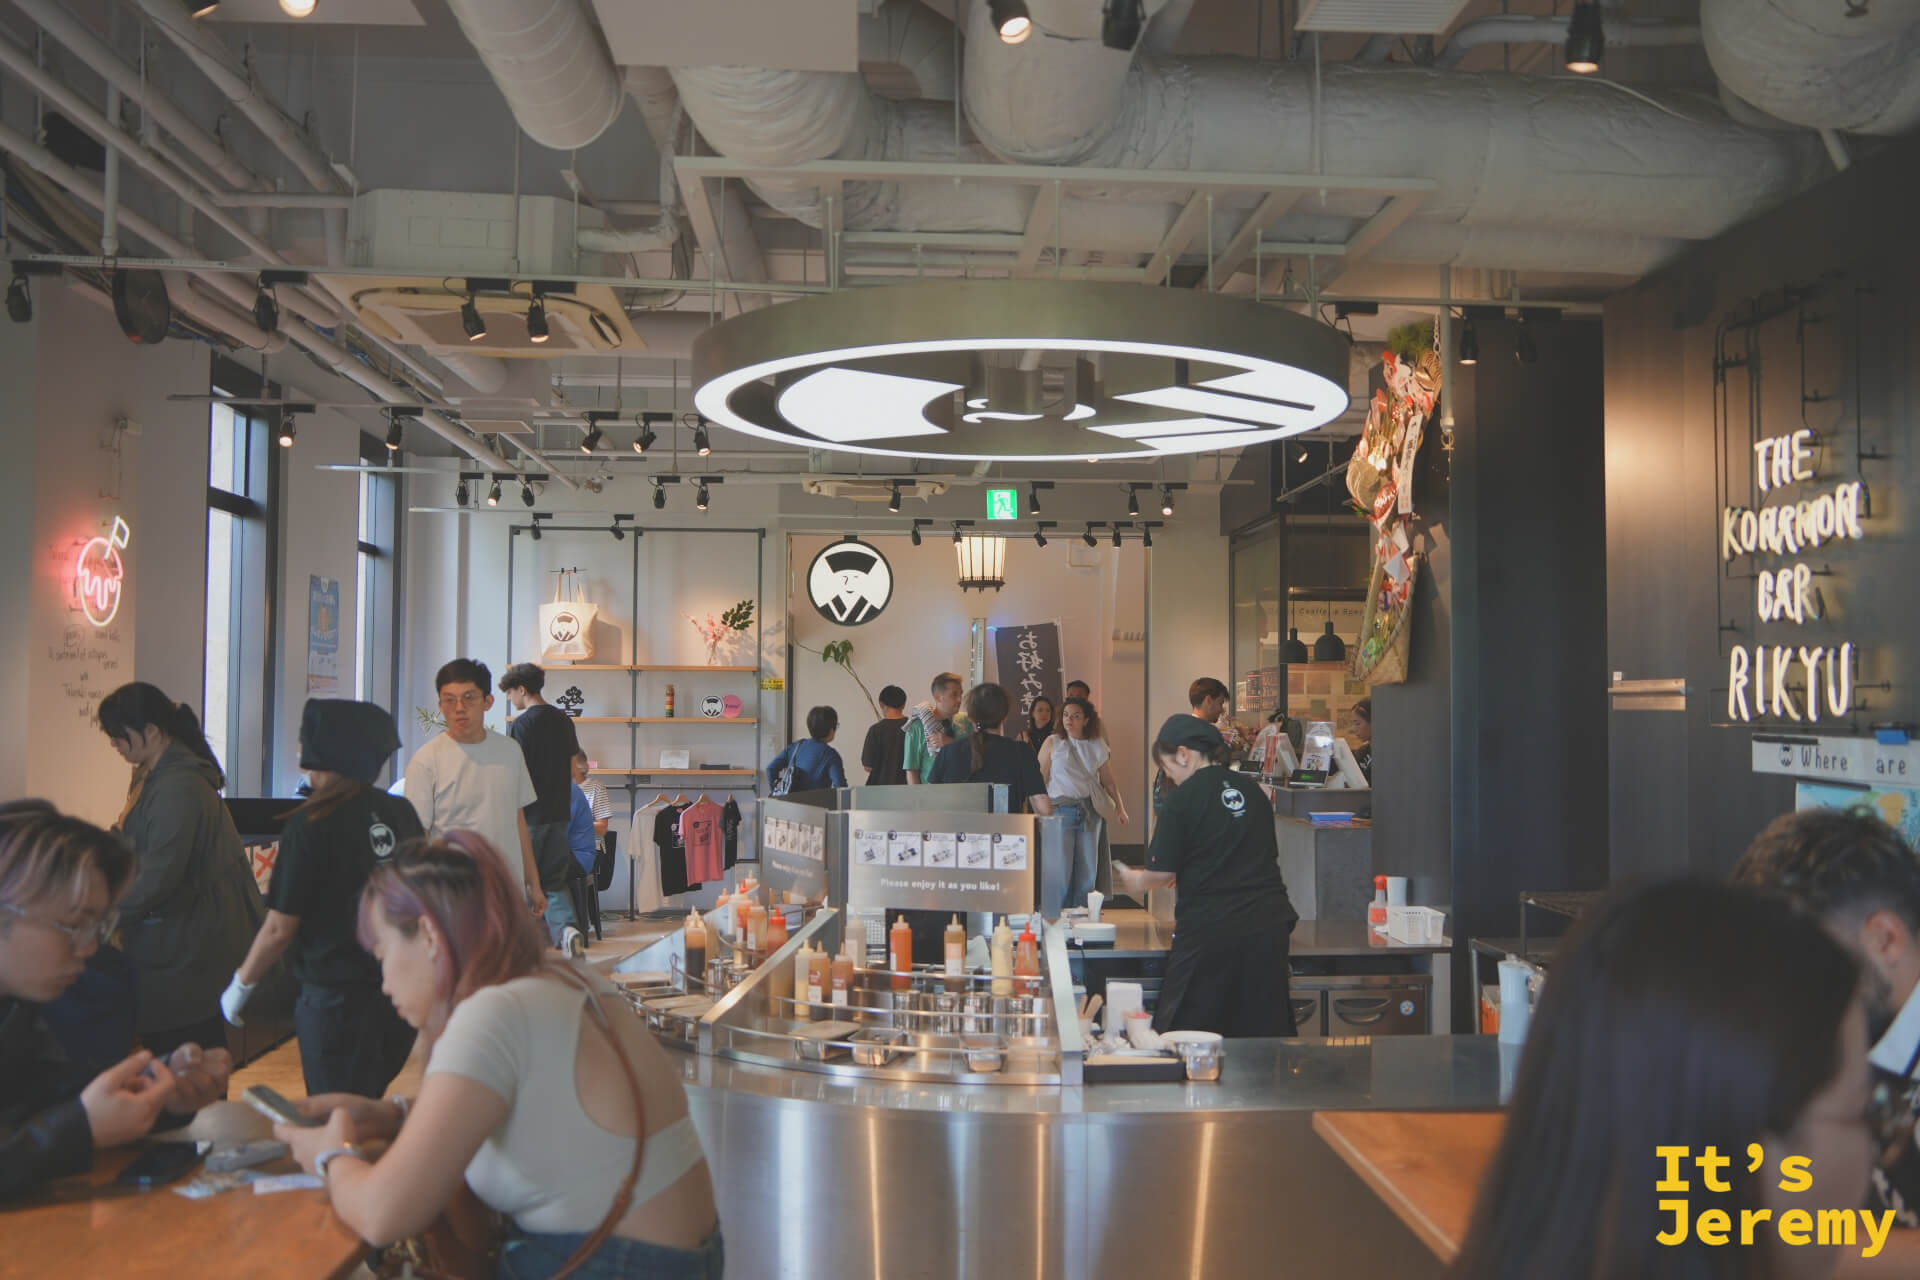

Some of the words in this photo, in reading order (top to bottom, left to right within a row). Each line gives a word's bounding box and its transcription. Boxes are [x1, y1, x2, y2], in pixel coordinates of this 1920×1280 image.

[1754, 429, 1813, 491] THE
[1758, 562, 1818, 624] BAR
[1728, 642, 1850, 722] RIKYU
[1801, 745, 1848, 770] Where
[1875, 758, 1907, 775] are
[880, 877, 909, 888] Please
[911, 879, 936, 891] enjoy
[938, 879, 945, 889] it
[948, 881, 958, 889] as
[960, 882, 977, 892] you
[979, 880, 1000, 891] like!
